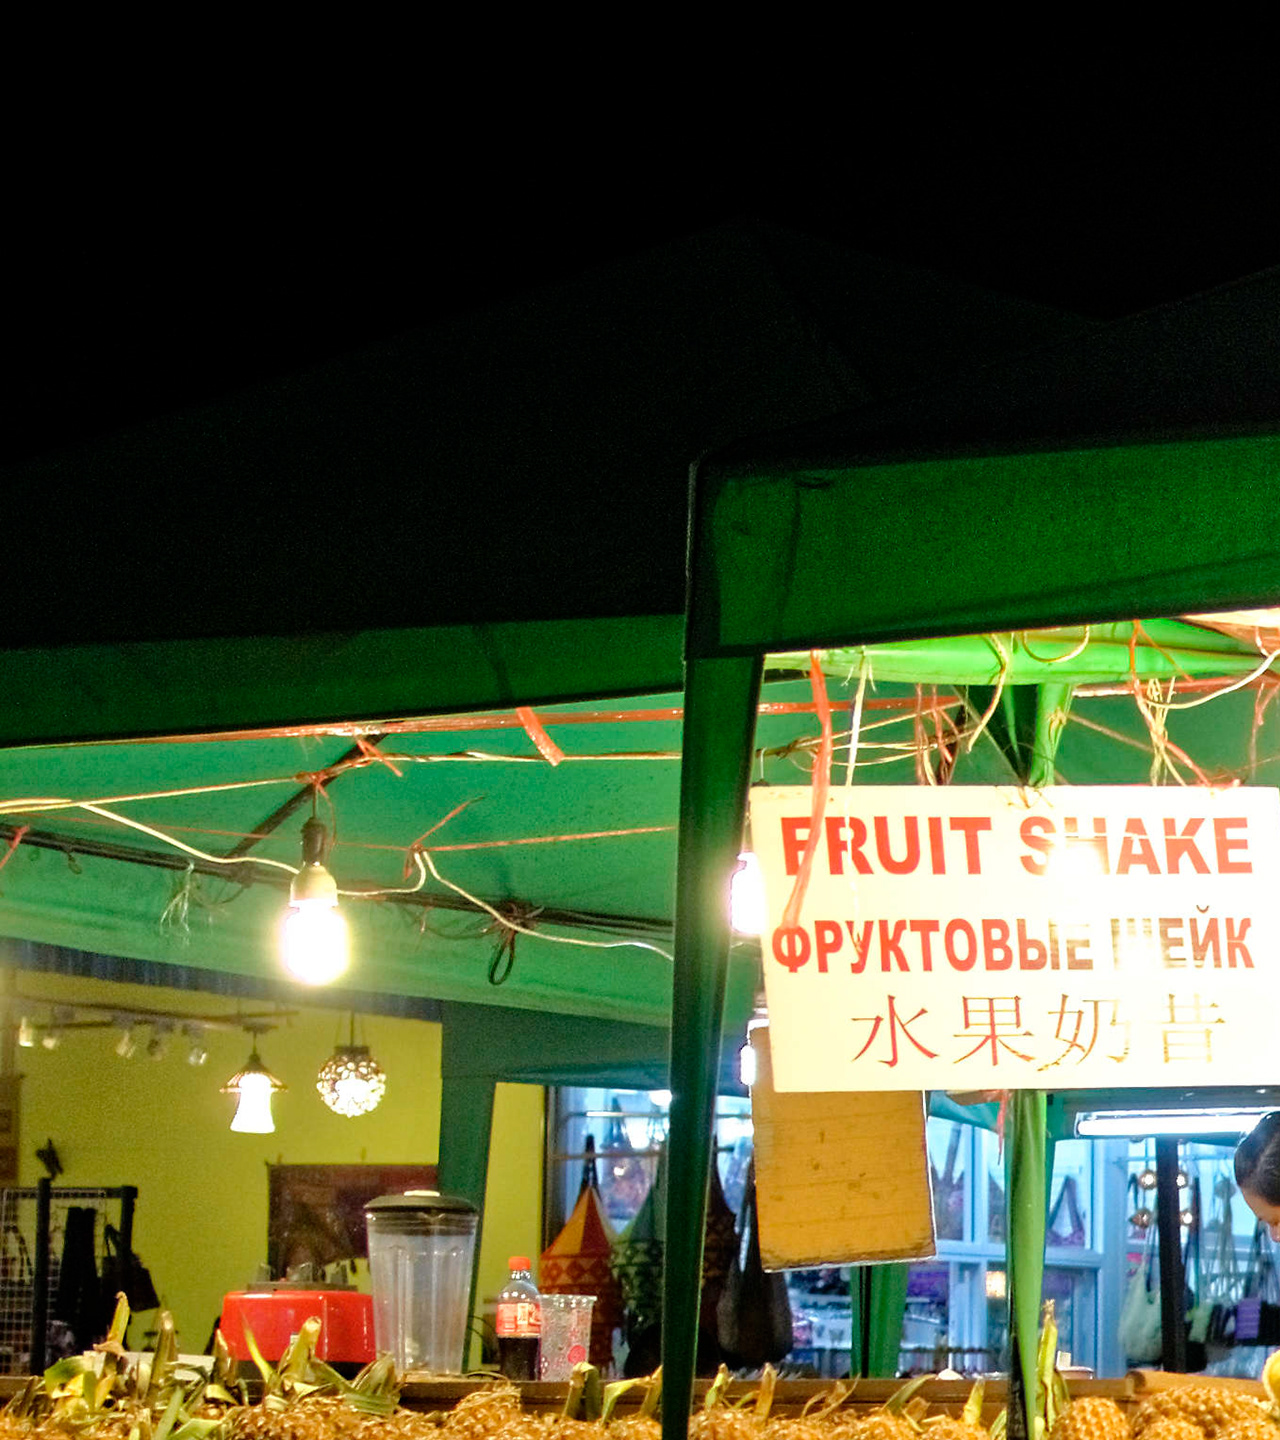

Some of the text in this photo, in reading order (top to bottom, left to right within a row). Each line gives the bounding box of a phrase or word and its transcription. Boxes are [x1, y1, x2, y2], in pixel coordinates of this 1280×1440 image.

[781, 816, 1253, 875] FRUIT SHAKE
[771, 916, 1094, 974] ФРУКТОВЫЕ
[850, 993, 1226, 1072] 水果奶昔
